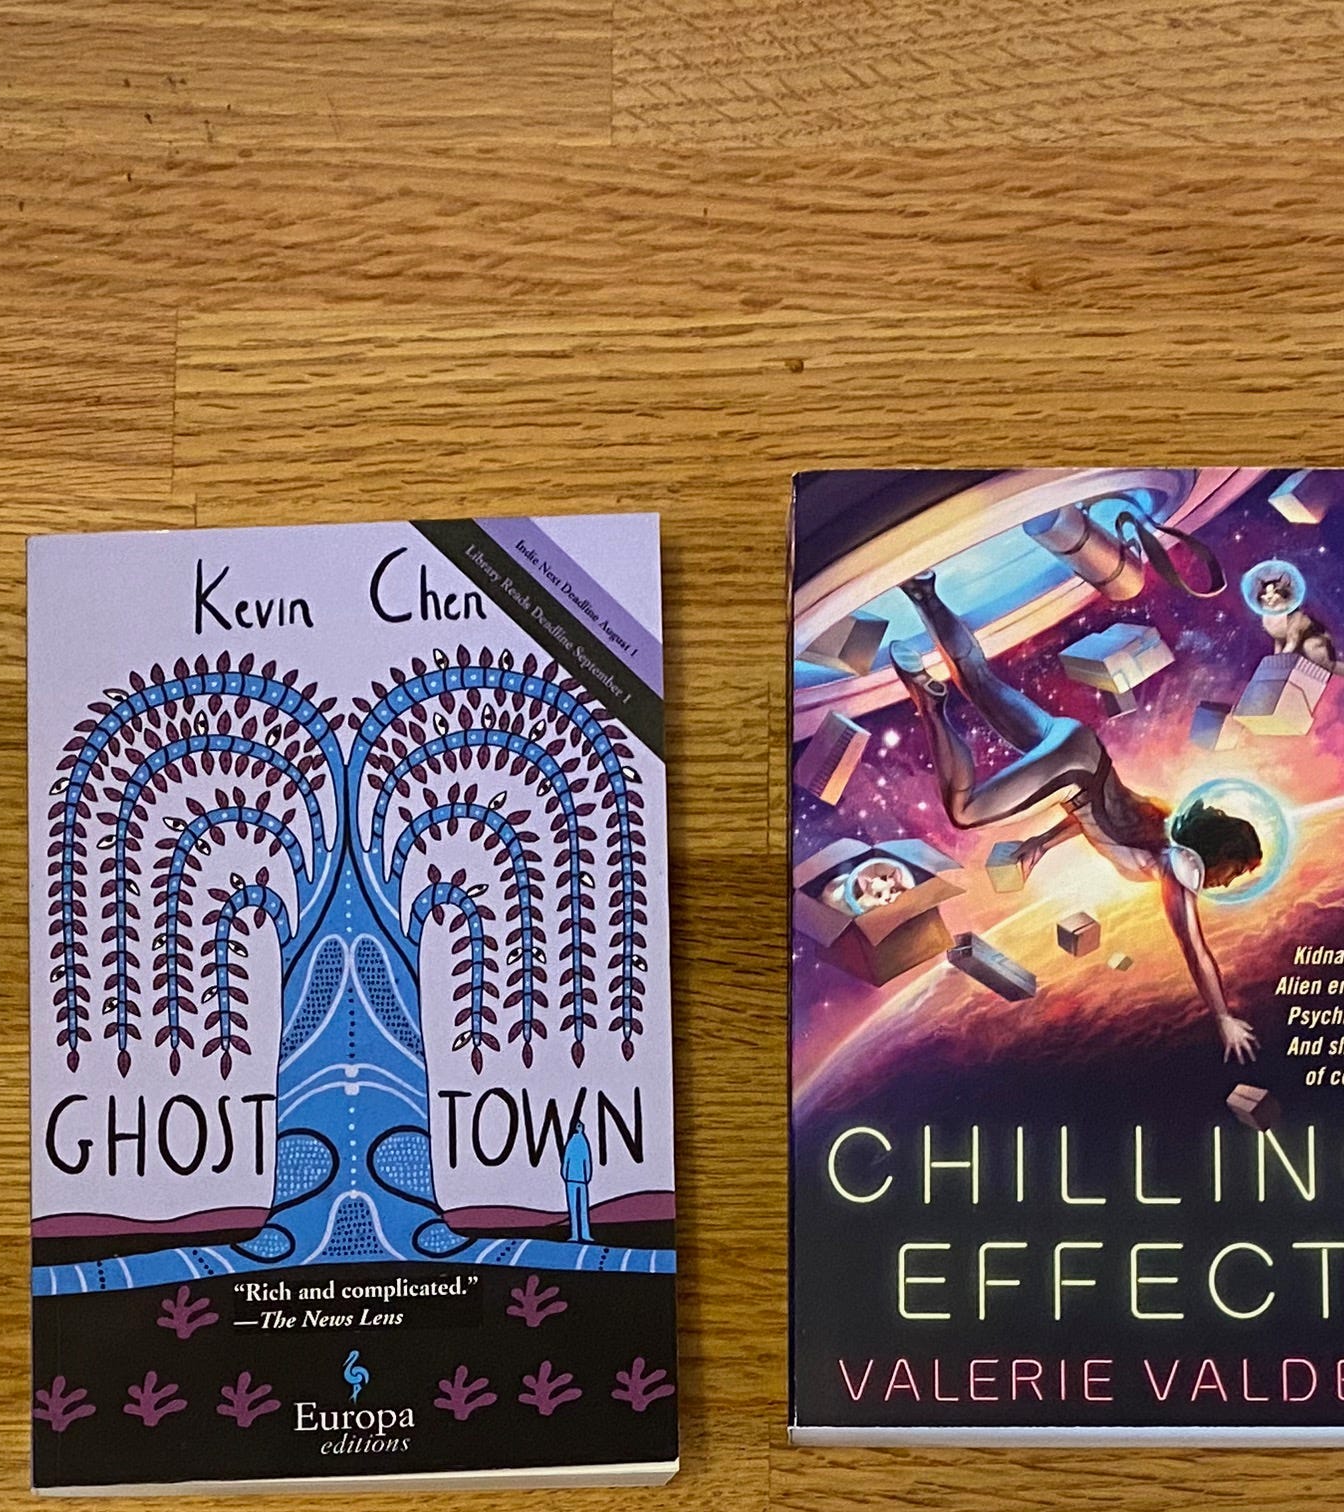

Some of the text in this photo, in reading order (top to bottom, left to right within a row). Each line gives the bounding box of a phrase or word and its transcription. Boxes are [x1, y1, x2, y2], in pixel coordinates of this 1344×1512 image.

[195, 547, 488, 634] Kevin Chen
[515, 539, 638, 657] Indie Next Deadline August 1
[465, 544, 631, 704] Library Reads Deadline September 1
[1276, 977, 1322, 996] Alien
[1287, 1037, 1322, 1056] And
[1305, 1065, 1325, 1086] of
[45, 1087, 644, 1177] GHOST TOWN
[299, 1281, 336, 1300] and
[301, 1310, 353, 1328] News
[359, 1308, 403, 1327] Lens
[838, 1358, 1113, 1402] VALERIE
[294, 1401, 416, 1433] Europa
[321, 1433, 411, 1456] editions
